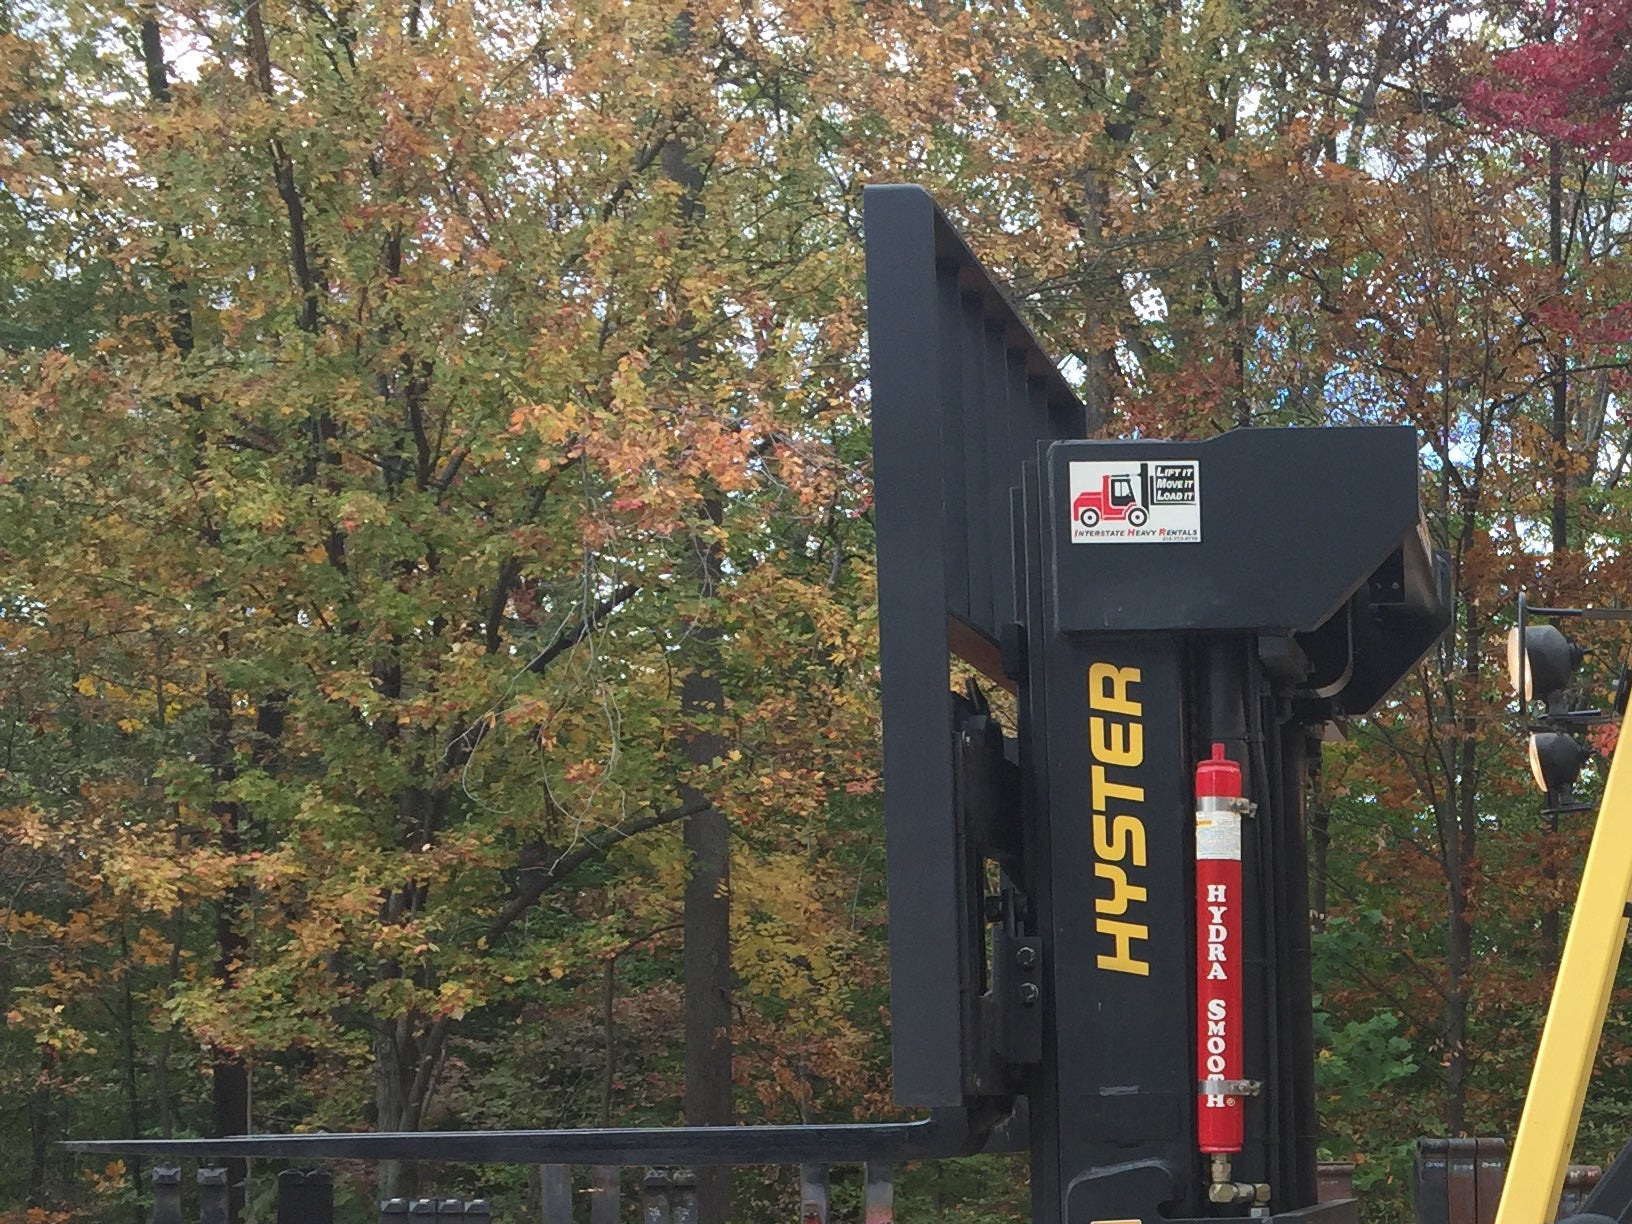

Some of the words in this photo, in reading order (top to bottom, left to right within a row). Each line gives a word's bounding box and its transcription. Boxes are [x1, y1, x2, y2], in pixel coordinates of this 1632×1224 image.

[1156, 466, 1182, 476] LIFT
[1182, 468, 1194, 476] IT
[1156, 478, 1184, 488] MOVE
[1184, 480, 1194, 488] IT
[1157, 490, 1183, 500] LOAD
[1184, 492, 1194, 500] IT
[1074, 529, 1125, 537] INTERSTATE
[1127, 528, 1157, 537] HEAVY
[1158, 528, 1198, 536] RENTALS
[1088, 661, 1150, 977] HYSTER
[1206, 884, 1228, 980] HYDRA
